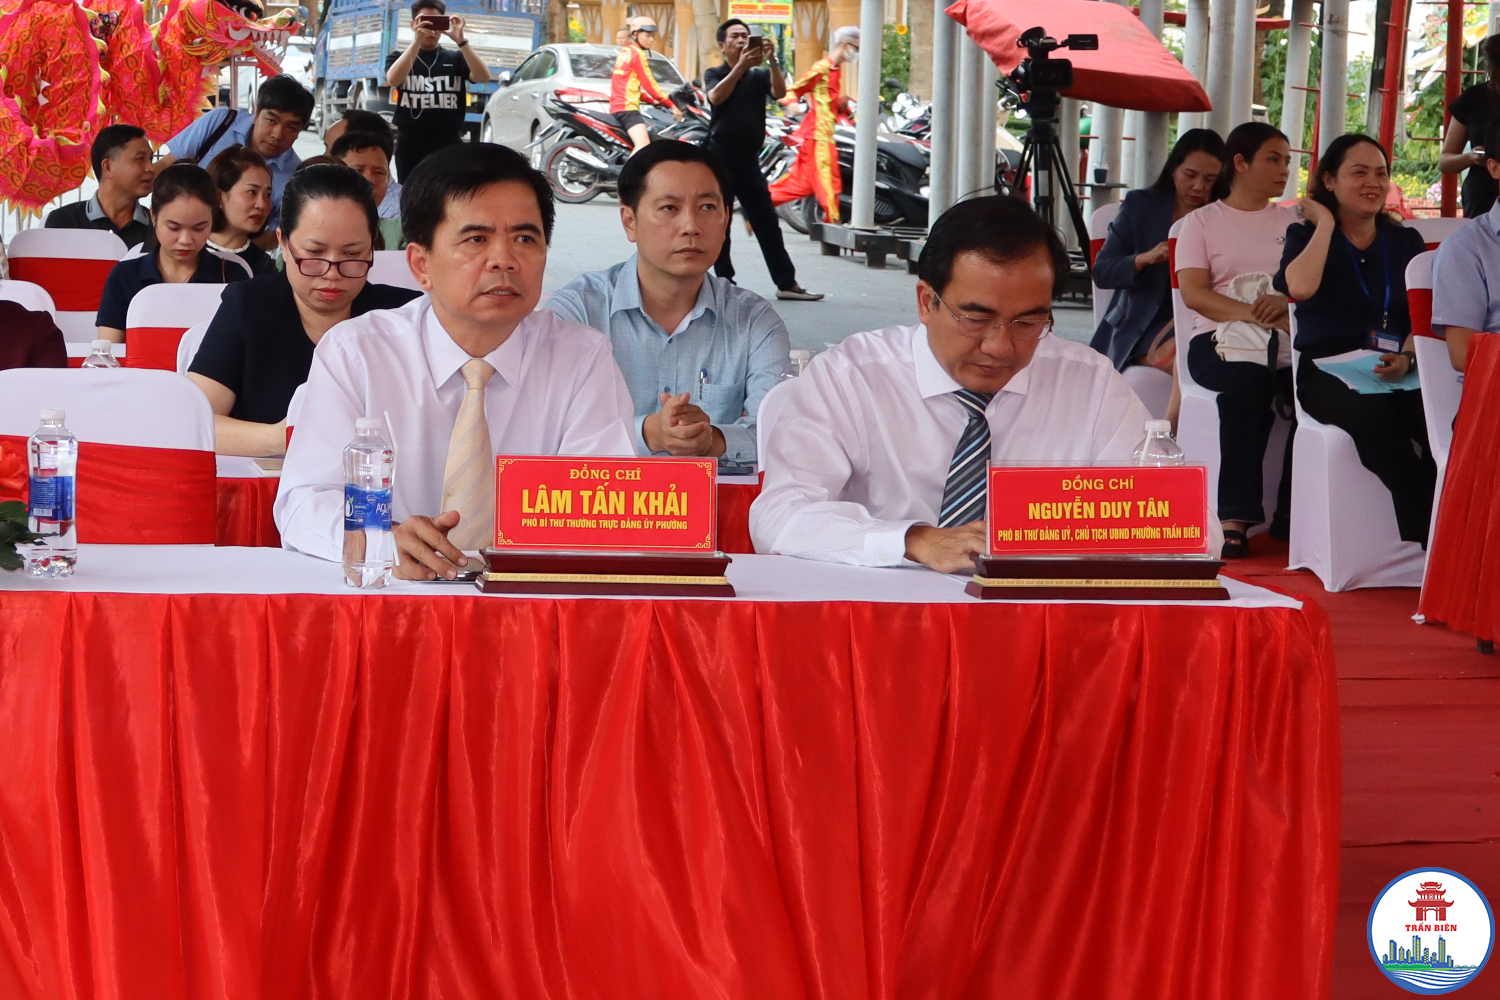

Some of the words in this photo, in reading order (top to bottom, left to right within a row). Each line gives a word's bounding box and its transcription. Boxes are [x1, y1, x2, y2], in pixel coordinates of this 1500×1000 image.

[399, 91, 458, 110] ATELIER
[569, 463, 611, 480] ĐỒNG
[614, 467, 642, 481] CHÍ
[1061, 474, 1104, 491] ĐỒNG
[1108, 475, 1134, 490] CHÍ
[521, 484, 572, 514] LÂM
[579, 481, 626, 515] TẤN
[632, 483, 688, 517] KHẢI
[1028, 495, 1095, 520] NGUYỄN
[1100, 501, 1133, 519] DUY
[1136, 497, 1170, 518] TÂN
[521, 516, 538, 528] PHÓ
[539, 516, 548, 528] BÍ
[549, 518, 566, 528] THƯ
[565, 517, 597, 529] THƯỜNG
[598, 519, 619, 531] TRỰC
[655, 518, 688, 530] PHƯỜNG
[997, 527, 1013, 542] PHÓ
[1014, 527, 1023, 542] BÍ
[1023, 528, 1039, 541] THƯ
[1039, 525, 1060, 541] ĐẢNG
[1074, 525, 1090, 541] CHỦ
[1091, 528, 1108, 543] TỊCH
[1109, 527, 1130, 540] UBND
[1131, 525, 1161, 540] PHƯỜNG
[1162, 523, 1182, 539] TRẤN
[1183, 524, 1201, 539] BIÊN
